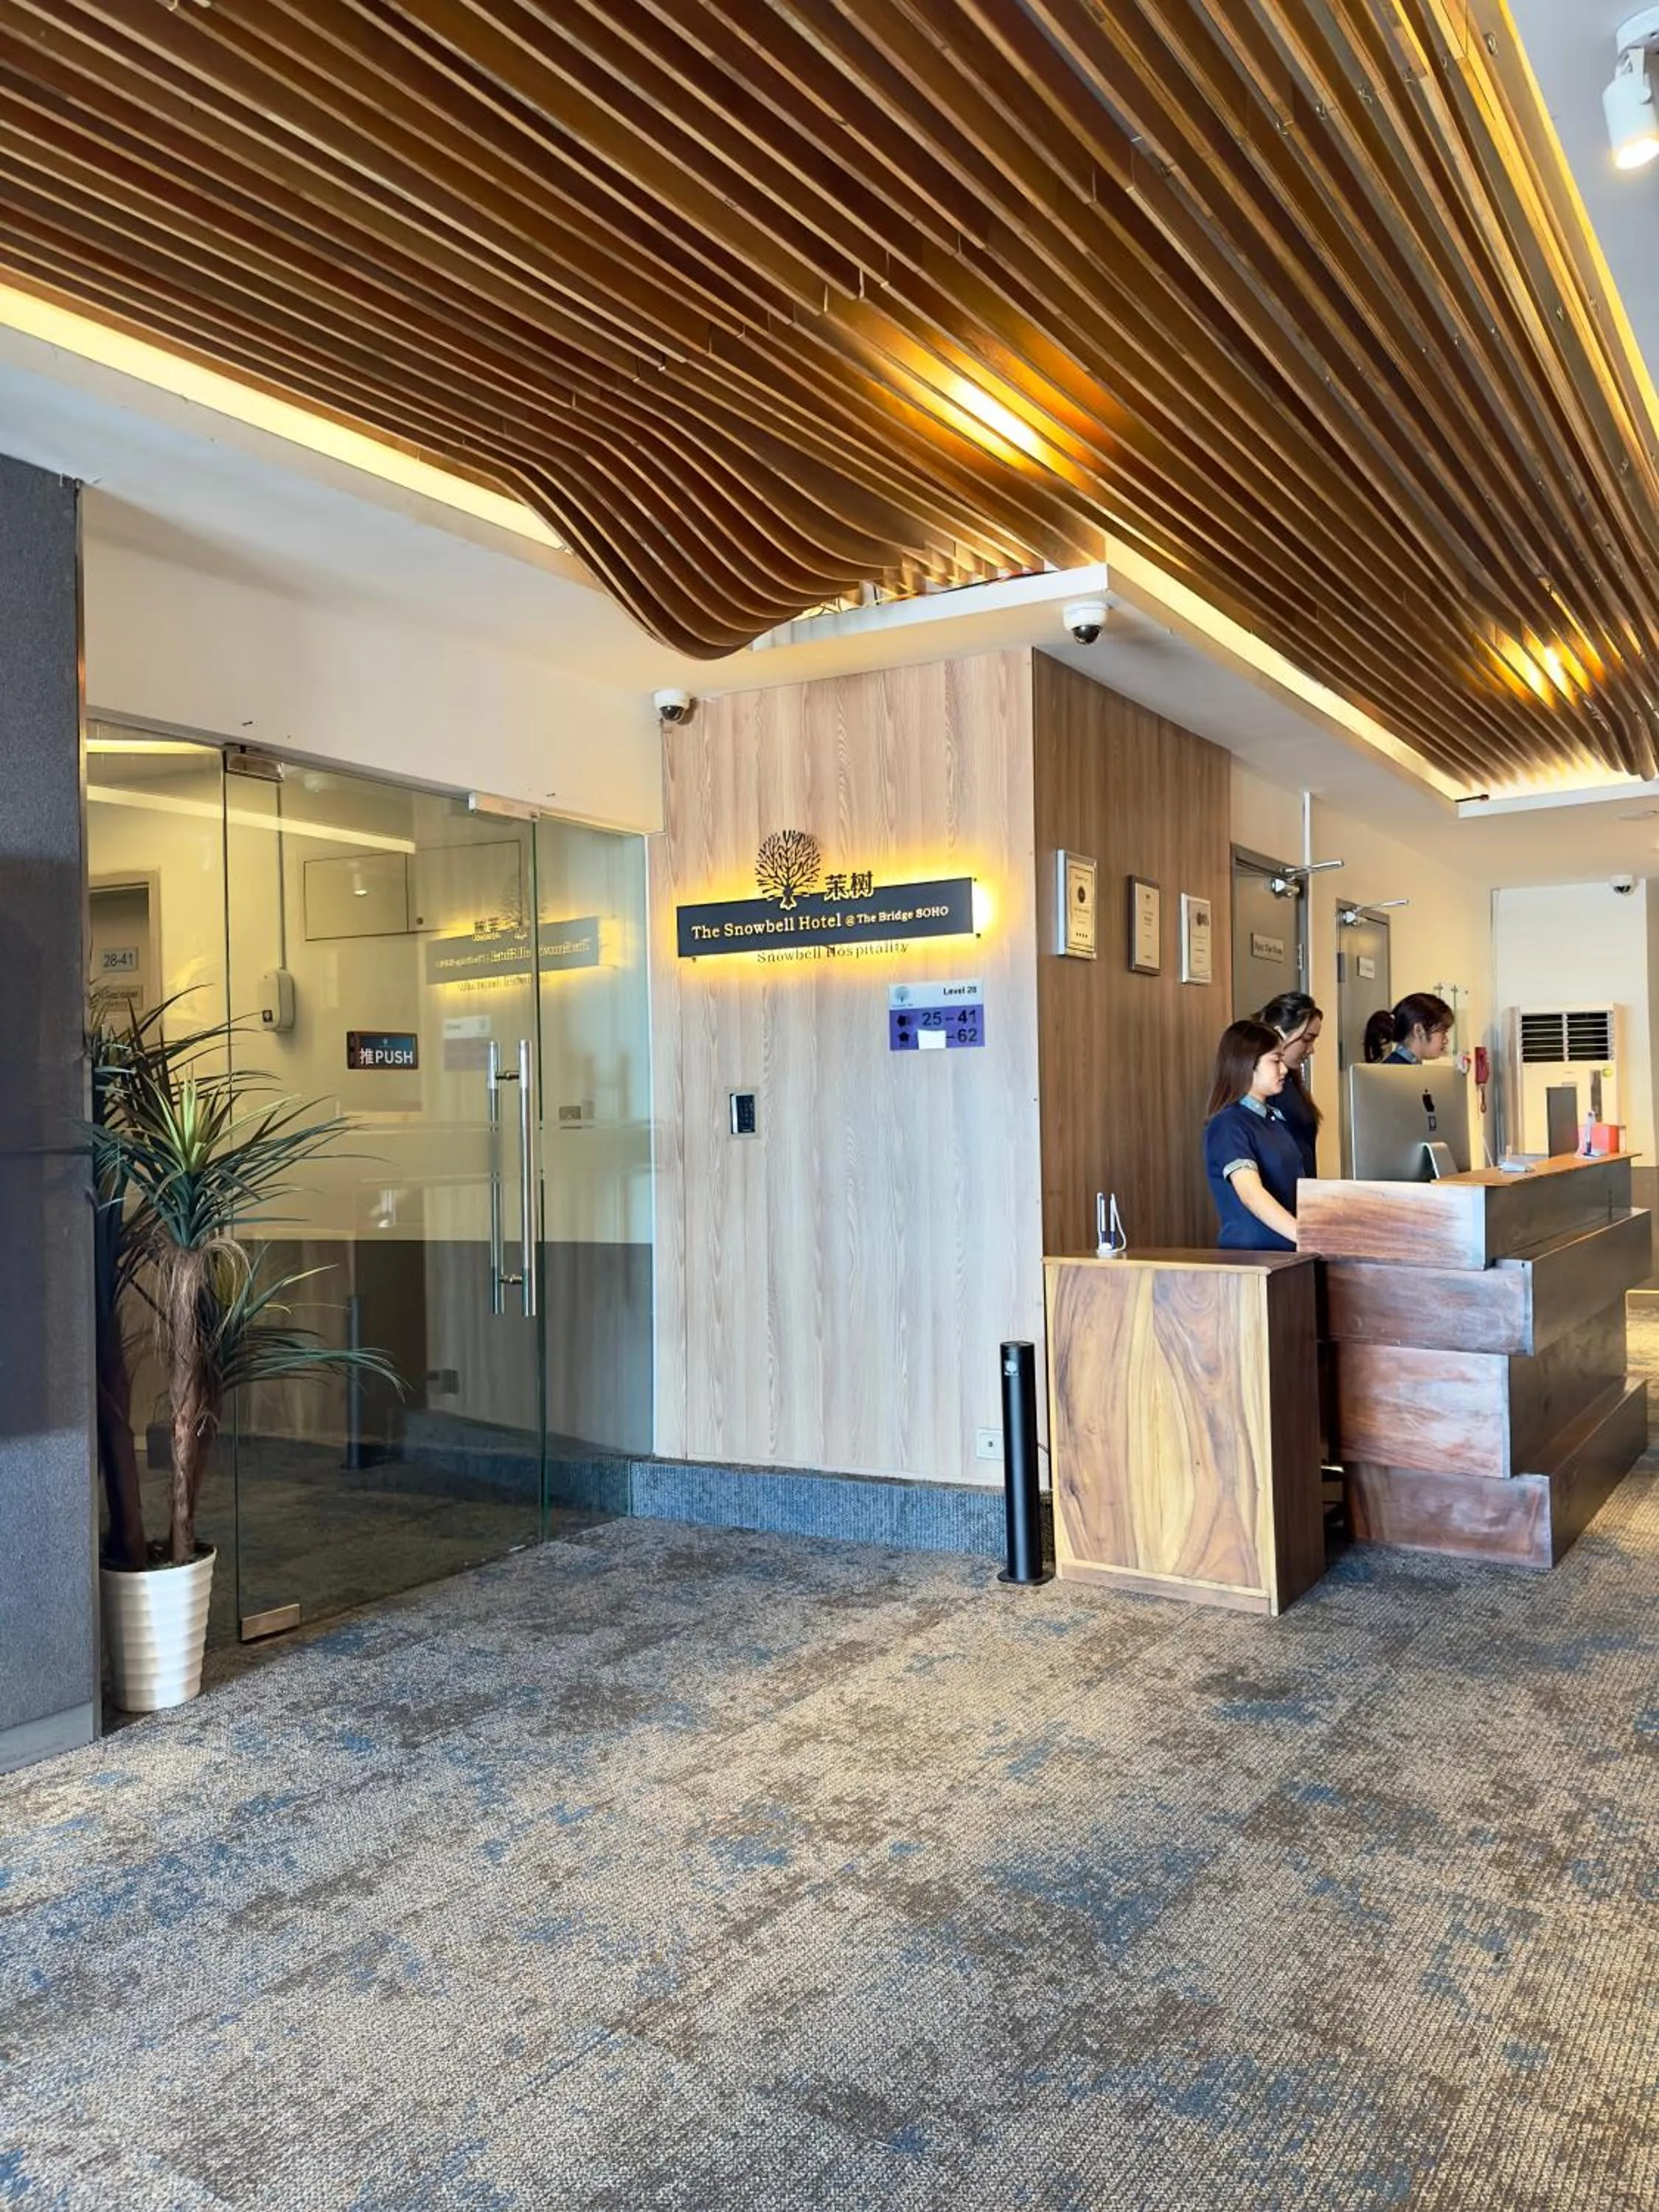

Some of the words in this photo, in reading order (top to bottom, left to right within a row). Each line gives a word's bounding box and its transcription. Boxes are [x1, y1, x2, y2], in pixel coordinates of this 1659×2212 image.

[692, 925, 720, 940] The
[723, 917, 794, 937] Snowbell
[799, 912, 841, 931] Hotel
[845, 914, 855, 926] @
[857, 913, 876, 924] The
[878, 909, 914, 922] Bridge
[915, 905, 950, 919] SOHO
[104, 952, 133, 968] 28-41
[757, 945, 821, 963] Snowbell
[827, 939, 909, 960] Hospitality
[943, 986, 965, 995] Level
